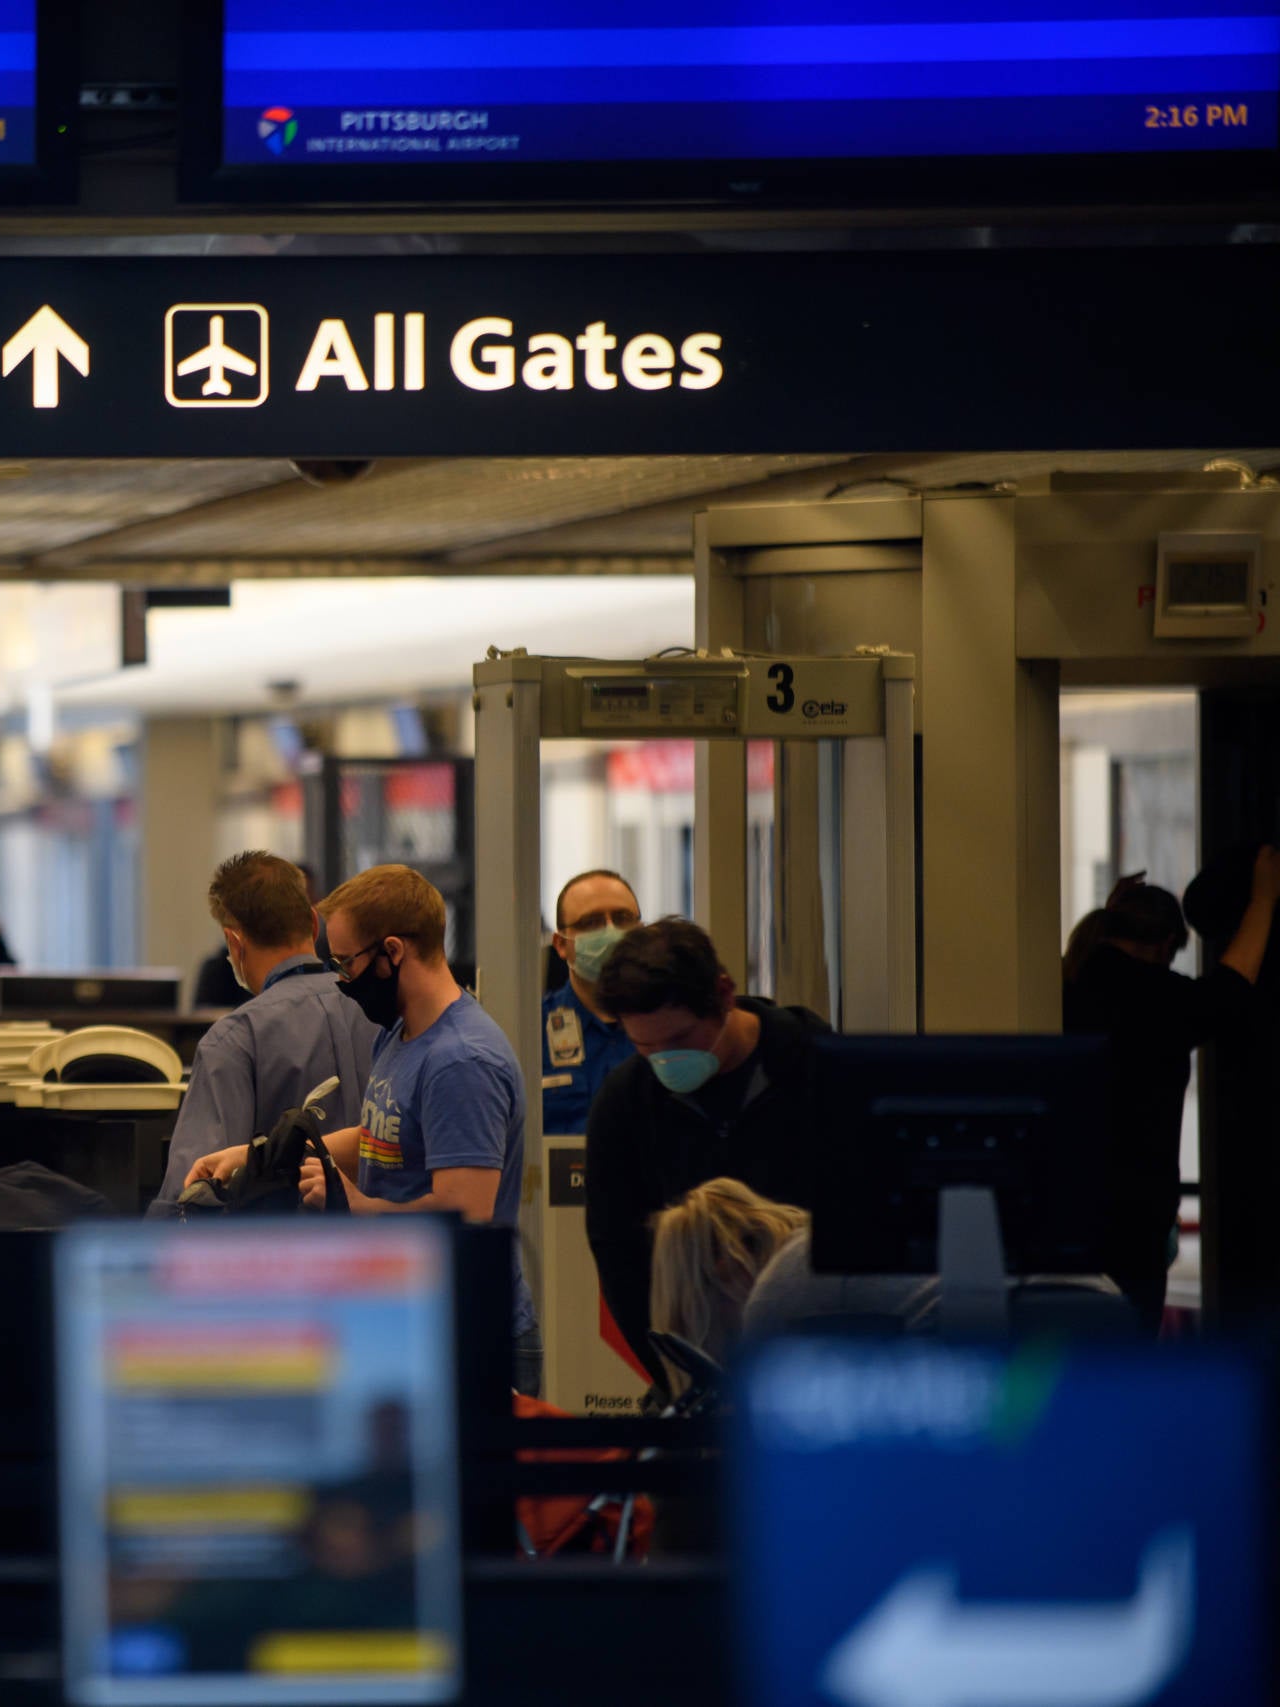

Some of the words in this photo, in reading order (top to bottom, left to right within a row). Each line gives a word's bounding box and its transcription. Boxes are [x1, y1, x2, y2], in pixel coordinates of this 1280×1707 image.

[340, 111, 489, 131] PITTSBURGH
[1145, 104, 1198, 128] 2:16
[1206, 104, 1247, 126] PM
[306, 138, 440, 152] INTERNATIONAL
[446, 136, 520, 151] AIRPORT
[294, 312, 425, 392] All
[449, 316, 724, 392] Gates
[766, 662, 795, 715] 3
[584, 1393, 633, 1409] Please
